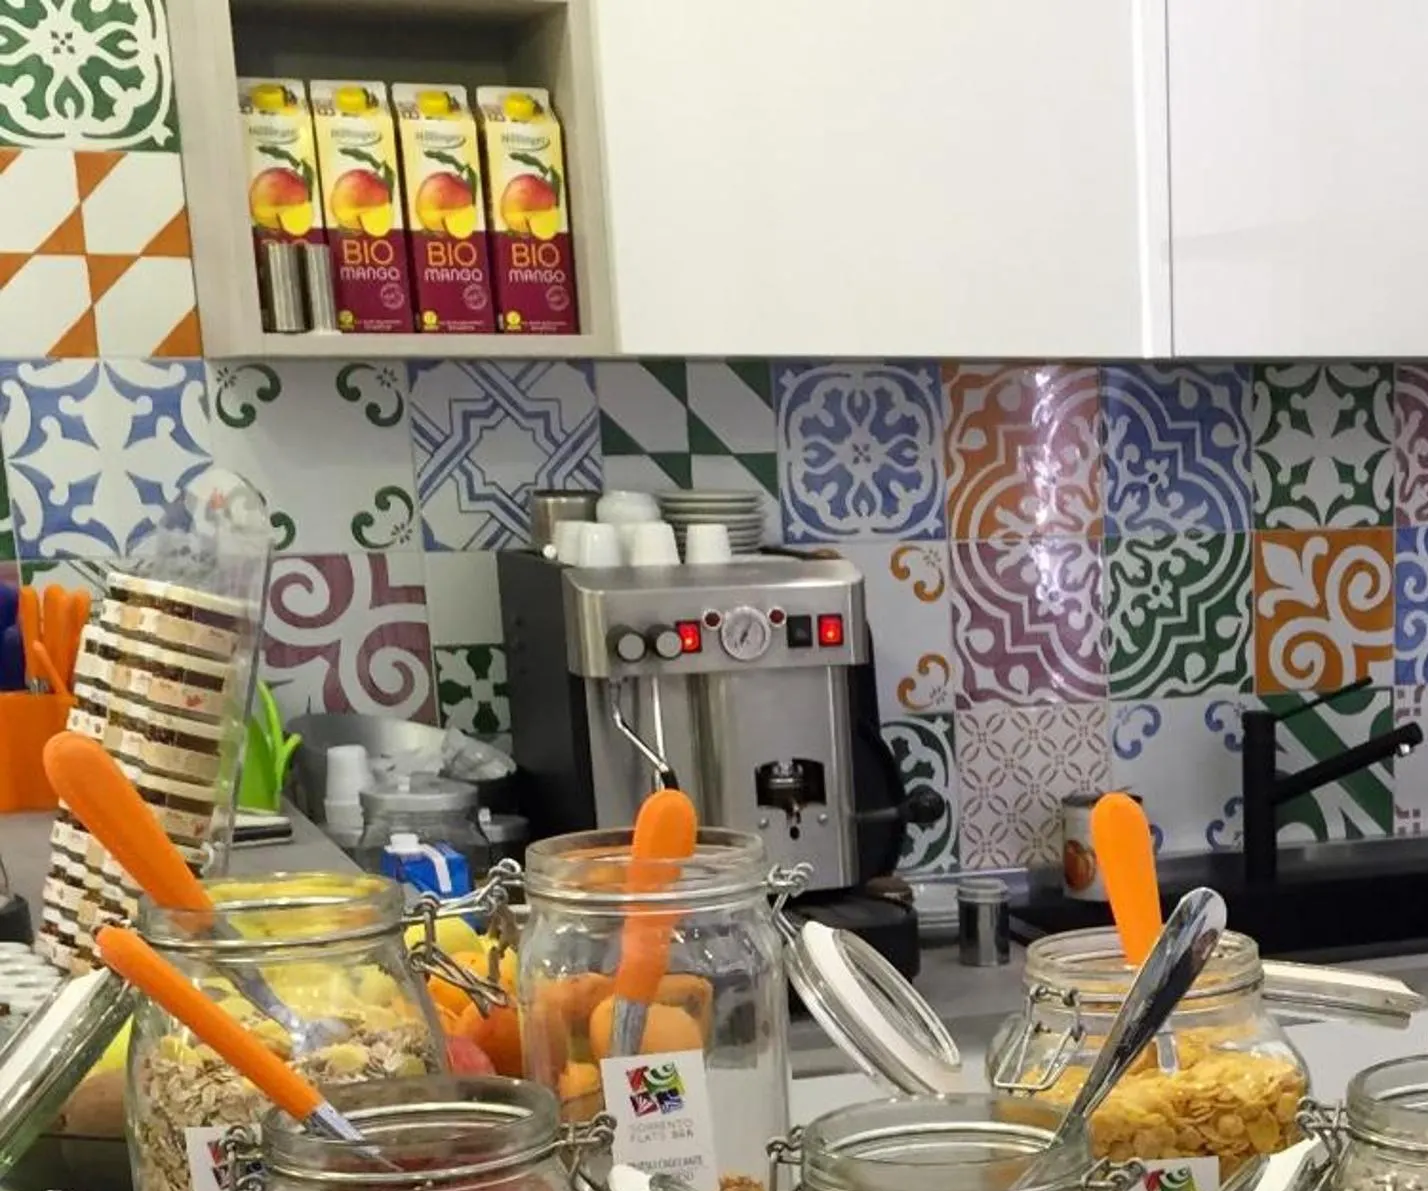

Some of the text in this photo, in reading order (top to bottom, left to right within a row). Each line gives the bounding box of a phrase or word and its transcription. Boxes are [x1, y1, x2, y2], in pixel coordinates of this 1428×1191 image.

[342, 240, 394, 266] BIO
[427, 242, 477, 267] BIO
[511, 243, 560, 268] BIO
